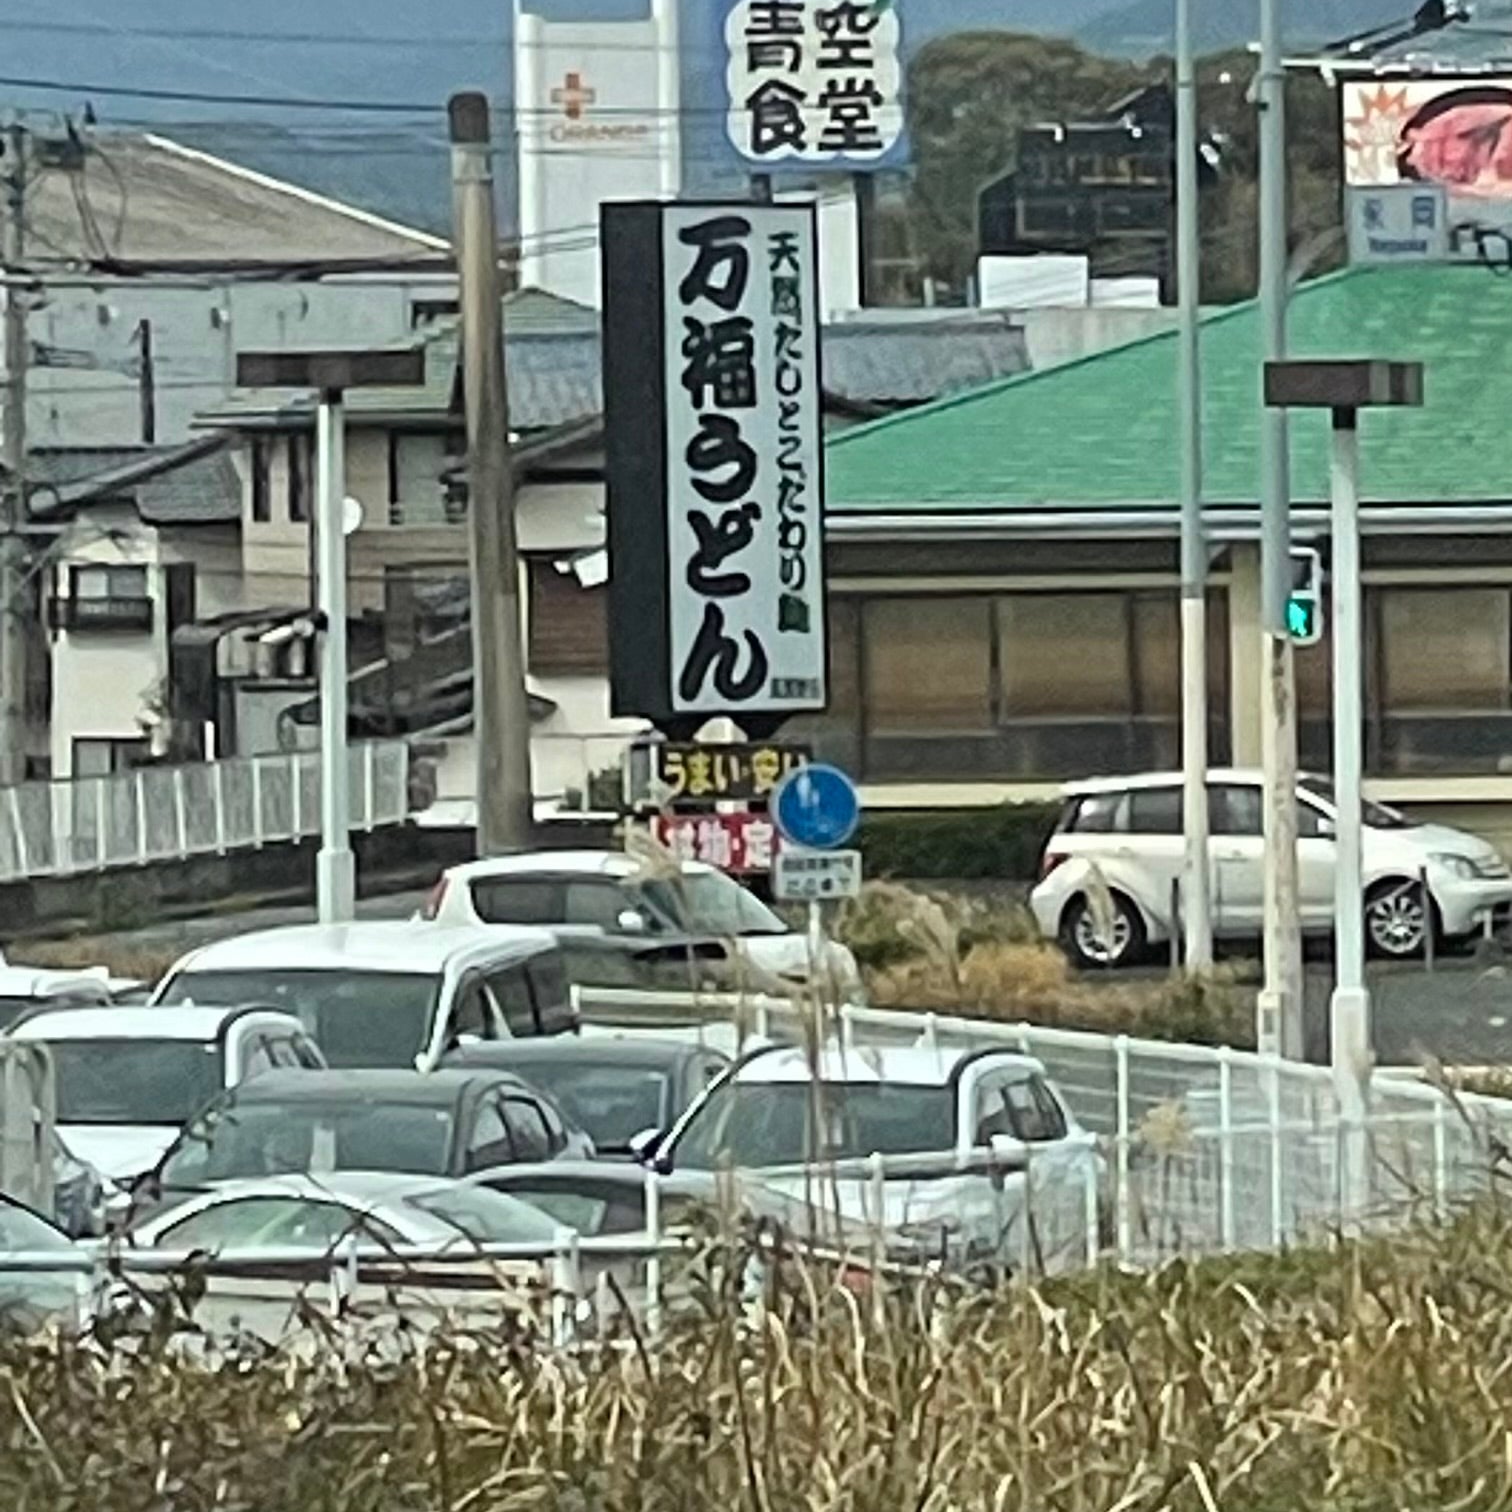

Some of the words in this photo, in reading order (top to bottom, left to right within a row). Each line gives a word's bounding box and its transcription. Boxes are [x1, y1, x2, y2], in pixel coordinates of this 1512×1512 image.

[745, 0, 878, 73] 青空
[745, 78, 883, 154] 食堂
[678, 216, 768, 702] 万福うどん
